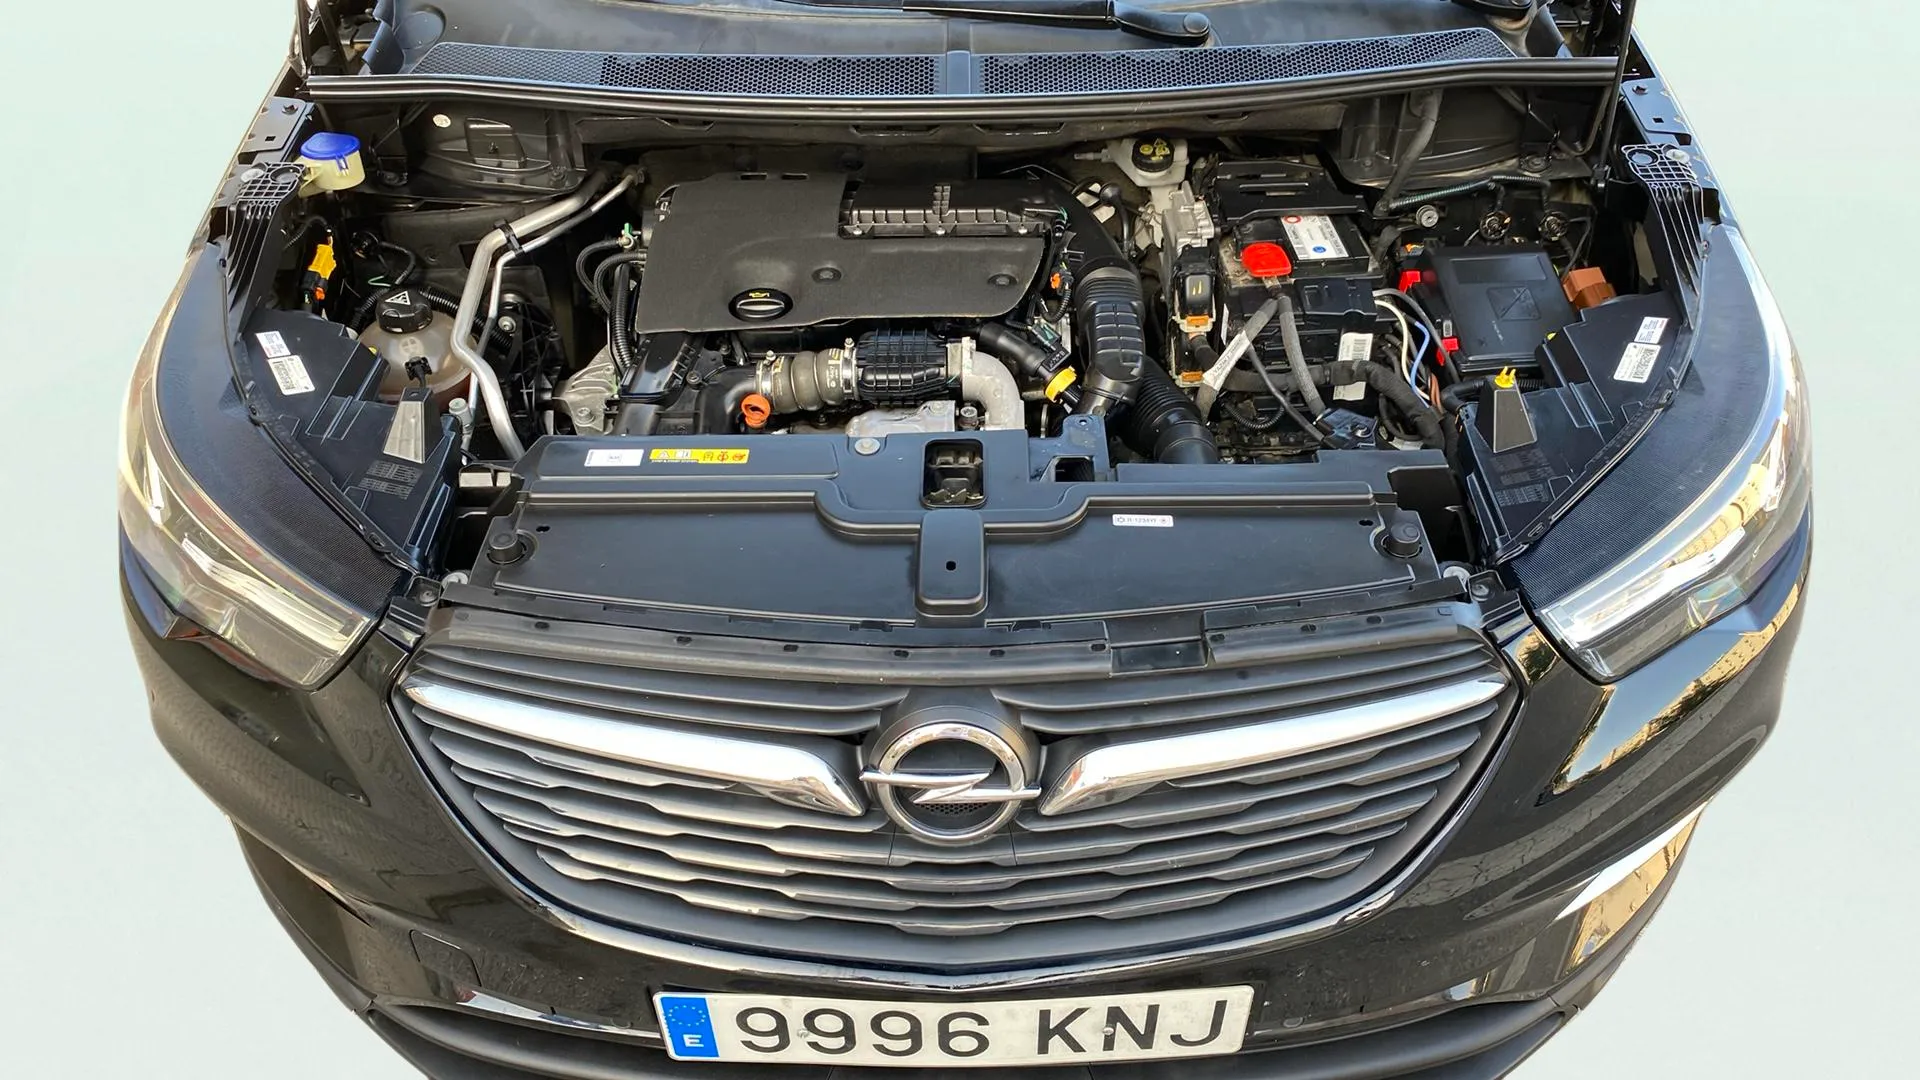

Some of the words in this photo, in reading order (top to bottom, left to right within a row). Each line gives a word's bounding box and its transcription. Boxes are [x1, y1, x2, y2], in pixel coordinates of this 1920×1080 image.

[683, 1034, 704, 1047] E
[736, 1006, 990, 1057] 9996
[1037, 1000, 1227, 1055] KNJ
